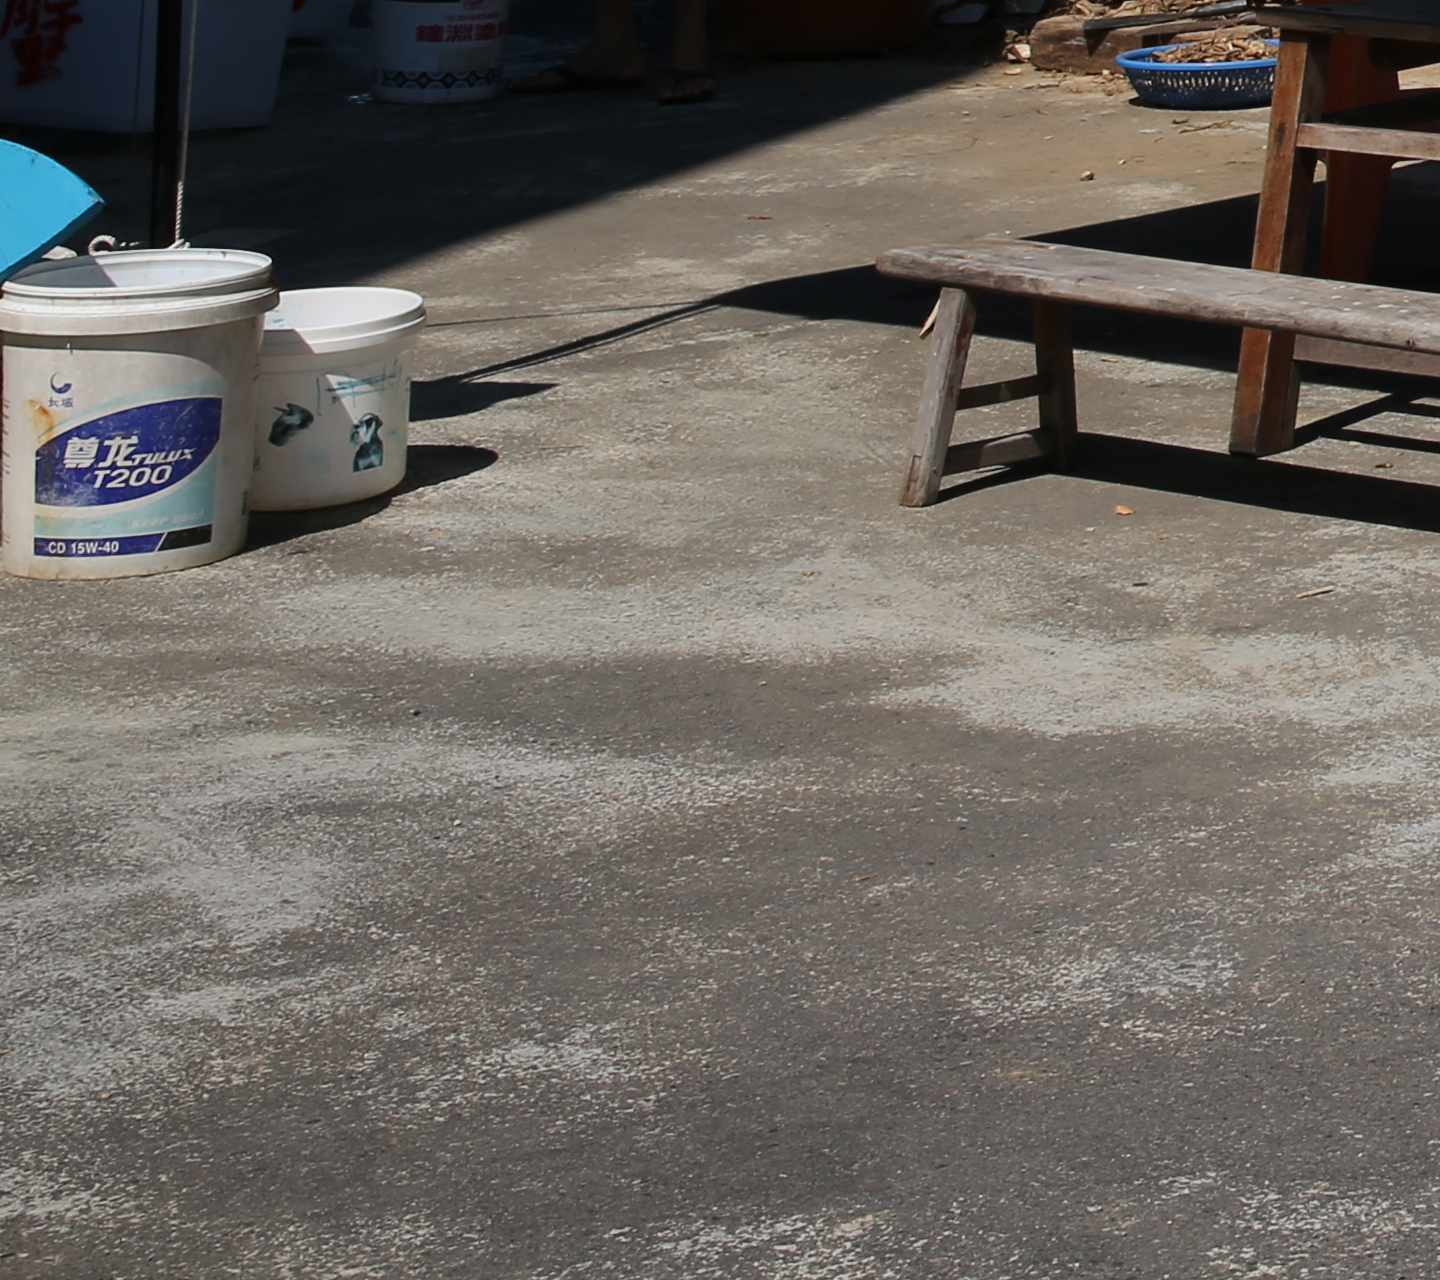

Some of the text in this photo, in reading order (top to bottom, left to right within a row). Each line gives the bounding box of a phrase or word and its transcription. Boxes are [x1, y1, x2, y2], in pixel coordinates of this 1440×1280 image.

[93, 467, 173, 490] T200
[48, 540, 120, 555] CD 15W-40
